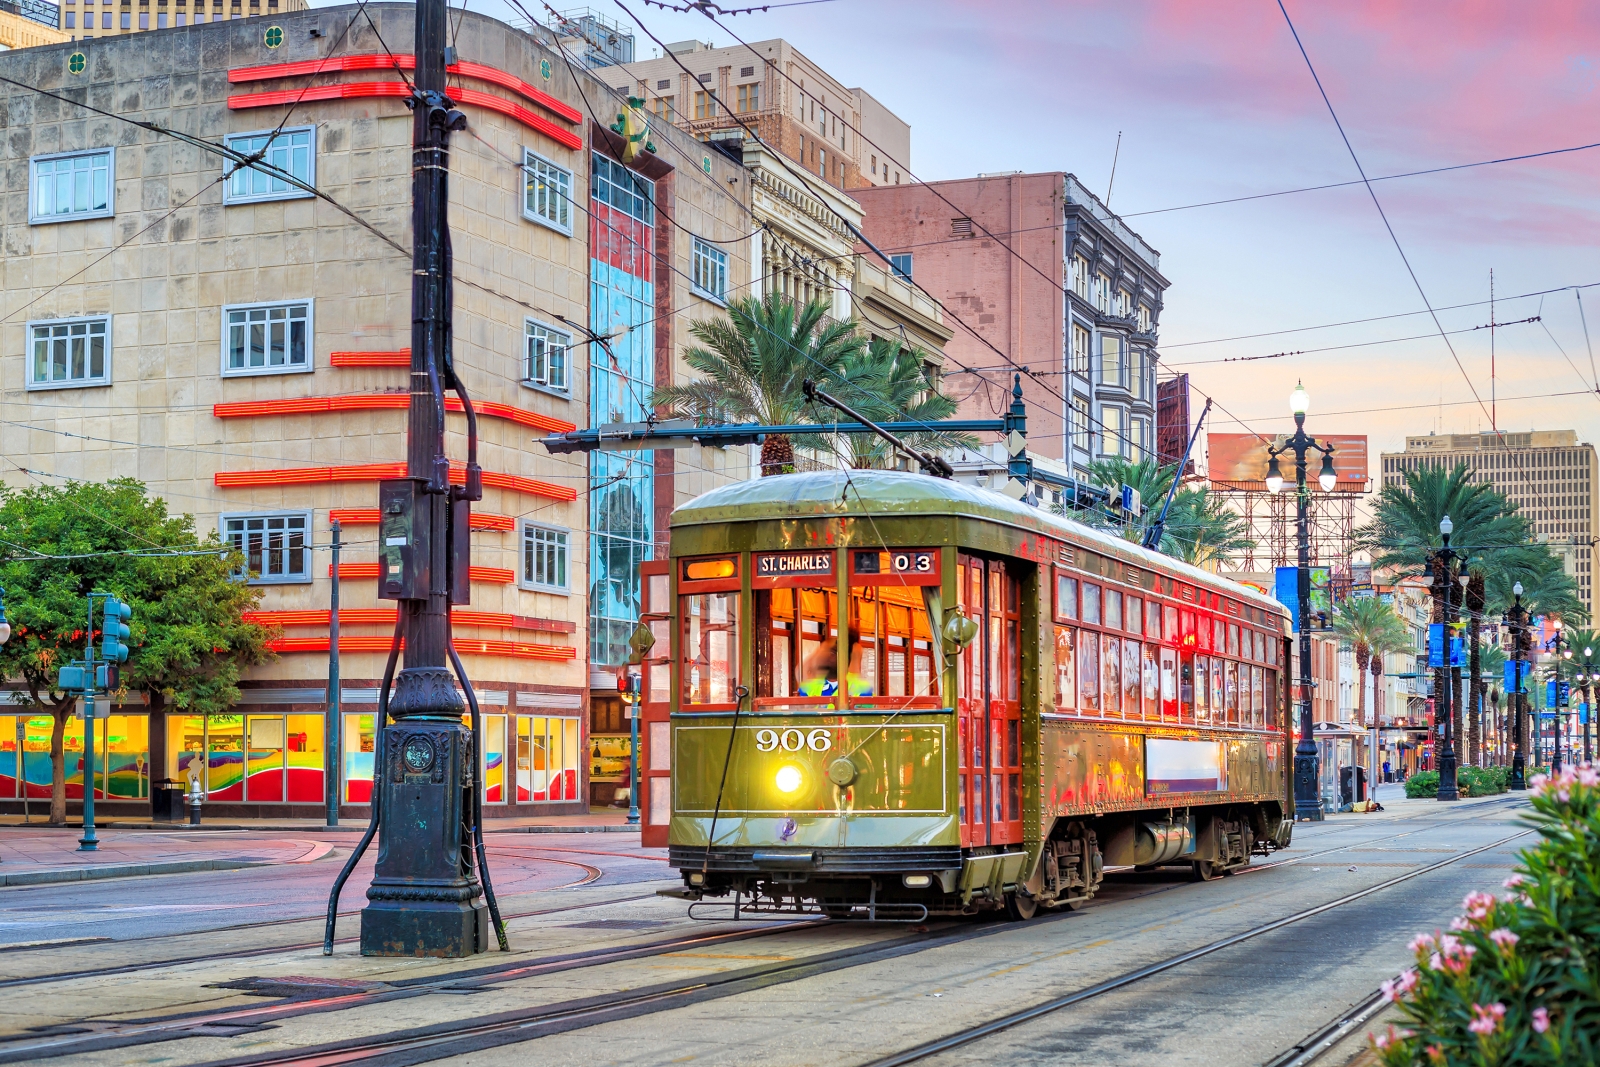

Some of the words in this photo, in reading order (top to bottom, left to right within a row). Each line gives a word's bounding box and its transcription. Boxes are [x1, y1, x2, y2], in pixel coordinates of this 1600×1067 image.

[761, 557, 778, 572] ST.
[779, 555, 830, 571] CHARLES
[755, 728, 832, 752] 906
